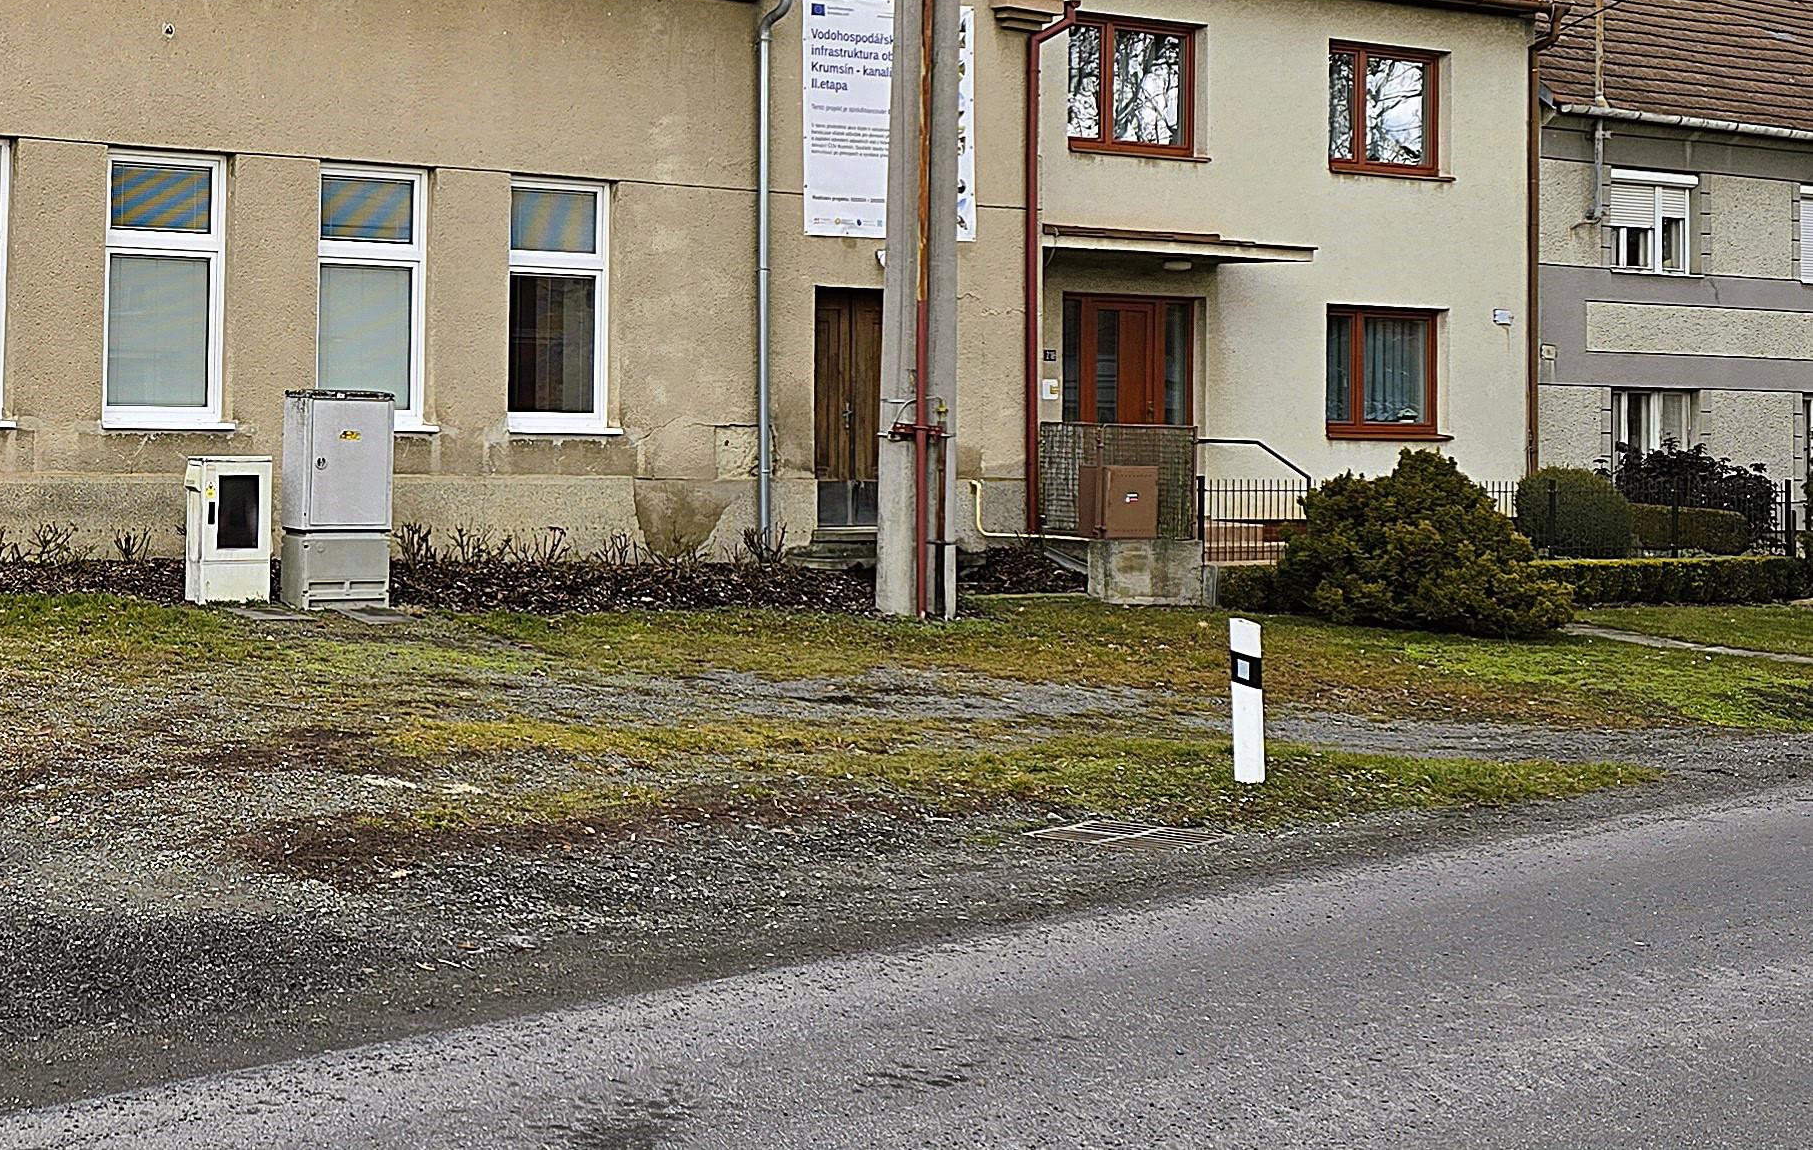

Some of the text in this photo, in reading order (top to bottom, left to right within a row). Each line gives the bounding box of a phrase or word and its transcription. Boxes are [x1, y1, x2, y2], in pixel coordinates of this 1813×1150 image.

[811, 44, 879, 60] infrastruktura
[811, 61, 854, 75] Krumsín
[811, 78, 848, 93] II.etapa
